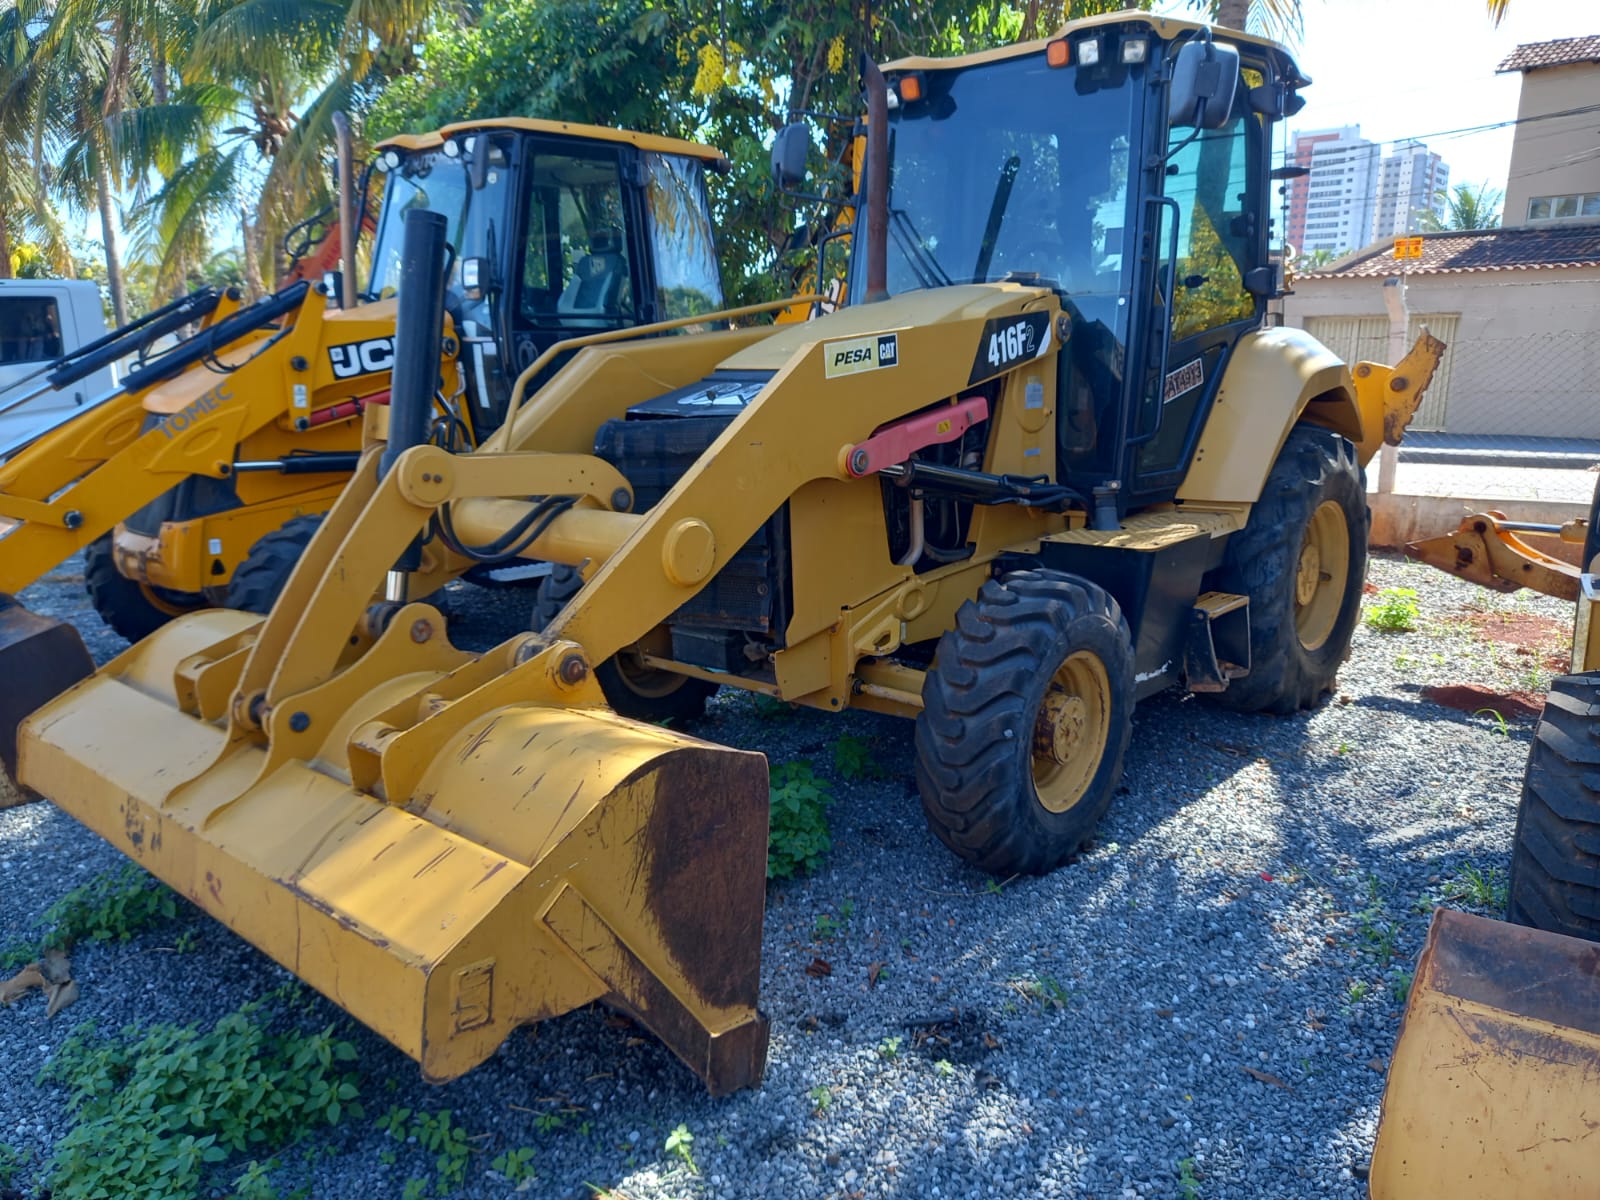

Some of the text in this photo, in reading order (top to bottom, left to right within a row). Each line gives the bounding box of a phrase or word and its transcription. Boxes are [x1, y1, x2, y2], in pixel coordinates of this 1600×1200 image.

[331, 338, 394, 378] JC
[834, 342, 895, 367] PESA CAT
[988, 320, 1035, 367] 416F2
[157, 382, 233, 440] TOMEC
